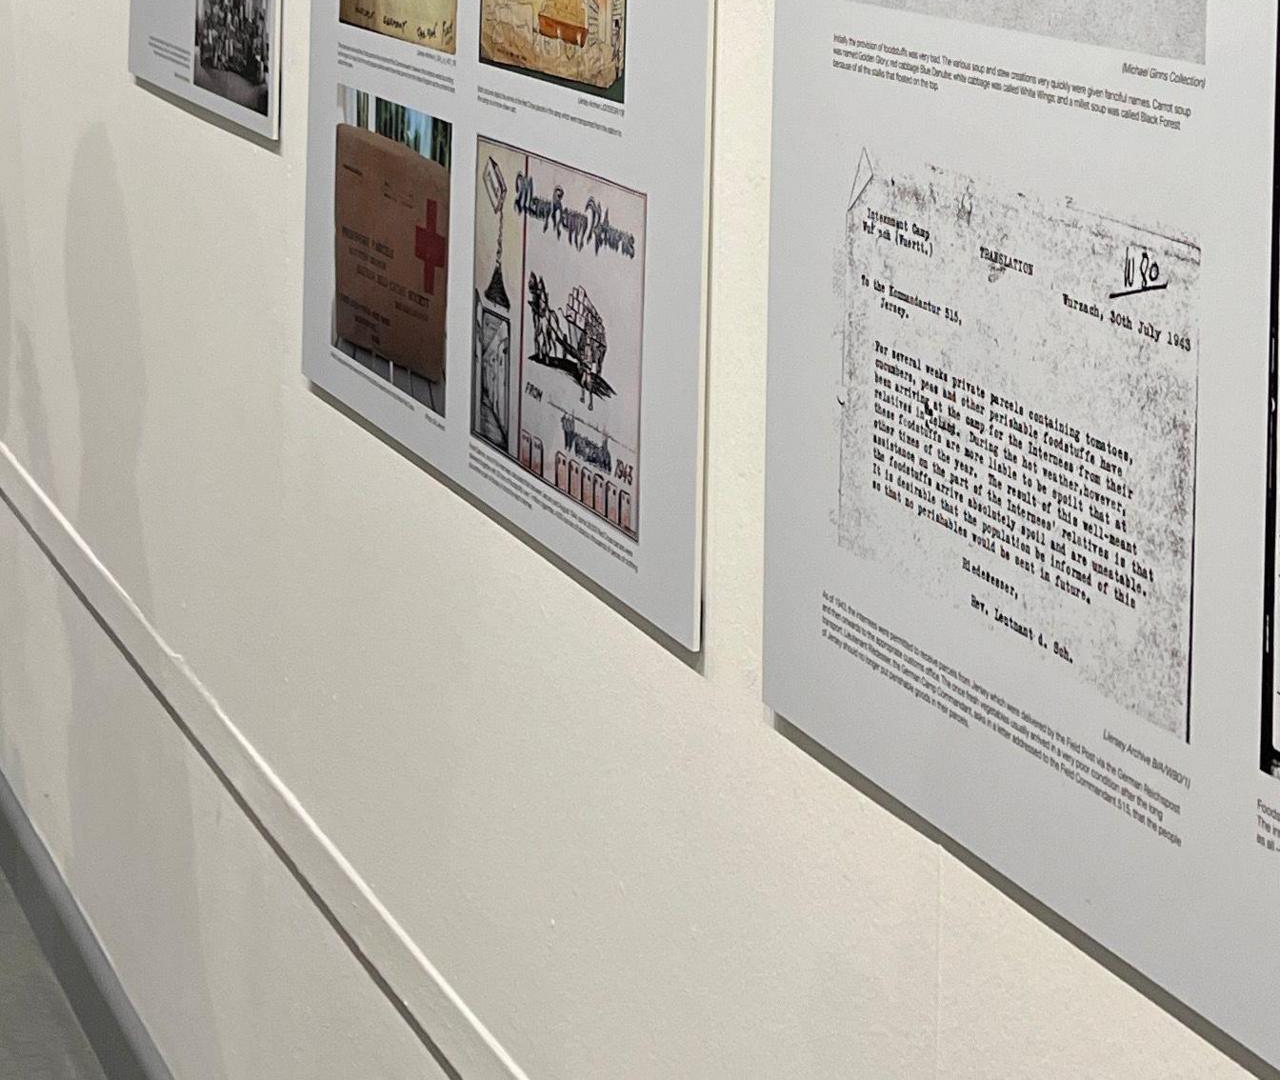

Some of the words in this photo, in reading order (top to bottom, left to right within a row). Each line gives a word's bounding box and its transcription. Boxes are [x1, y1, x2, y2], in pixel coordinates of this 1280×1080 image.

[514, 170, 552, 234] Many
[551, 184, 588, 252] Happy
[585, 195, 635, 260] Returns
[979, 246, 1034, 275] TRANSLATION
[860, 274, 869, 287] To
[873, 279, 885, 293] the
[888, 285, 941, 315] Kommandantur
[944, 307, 962, 326] 515,
[1062, 293, 1104, 321] Wurzach,
[1109, 310, 1132, 330] 30th
[1137, 321, 1162, 342] July
[1167, 331, 1191, 352] 1943
[874, 342, 888, 355] For
[892, 350, 921, 370] several
[925, 364, 948, 382] weeks
[951, 376, 985, 398] private
[989, 393, 1024, 415] parcels
[1028, 410, 1080, 442] containing
[1085, 433, 1133, 465] tomatoes,
[874, 359, 916, 385] cucumbers,
[920, 378, 938, 395] peas
[942, 387, 956, 403] and
[961, 397, 985, 415] other
[988, 410, 1038, 439] perishable
[1043, 432, 1095, 464] foodstuffs
[1099, 456, 1122, 477] have
